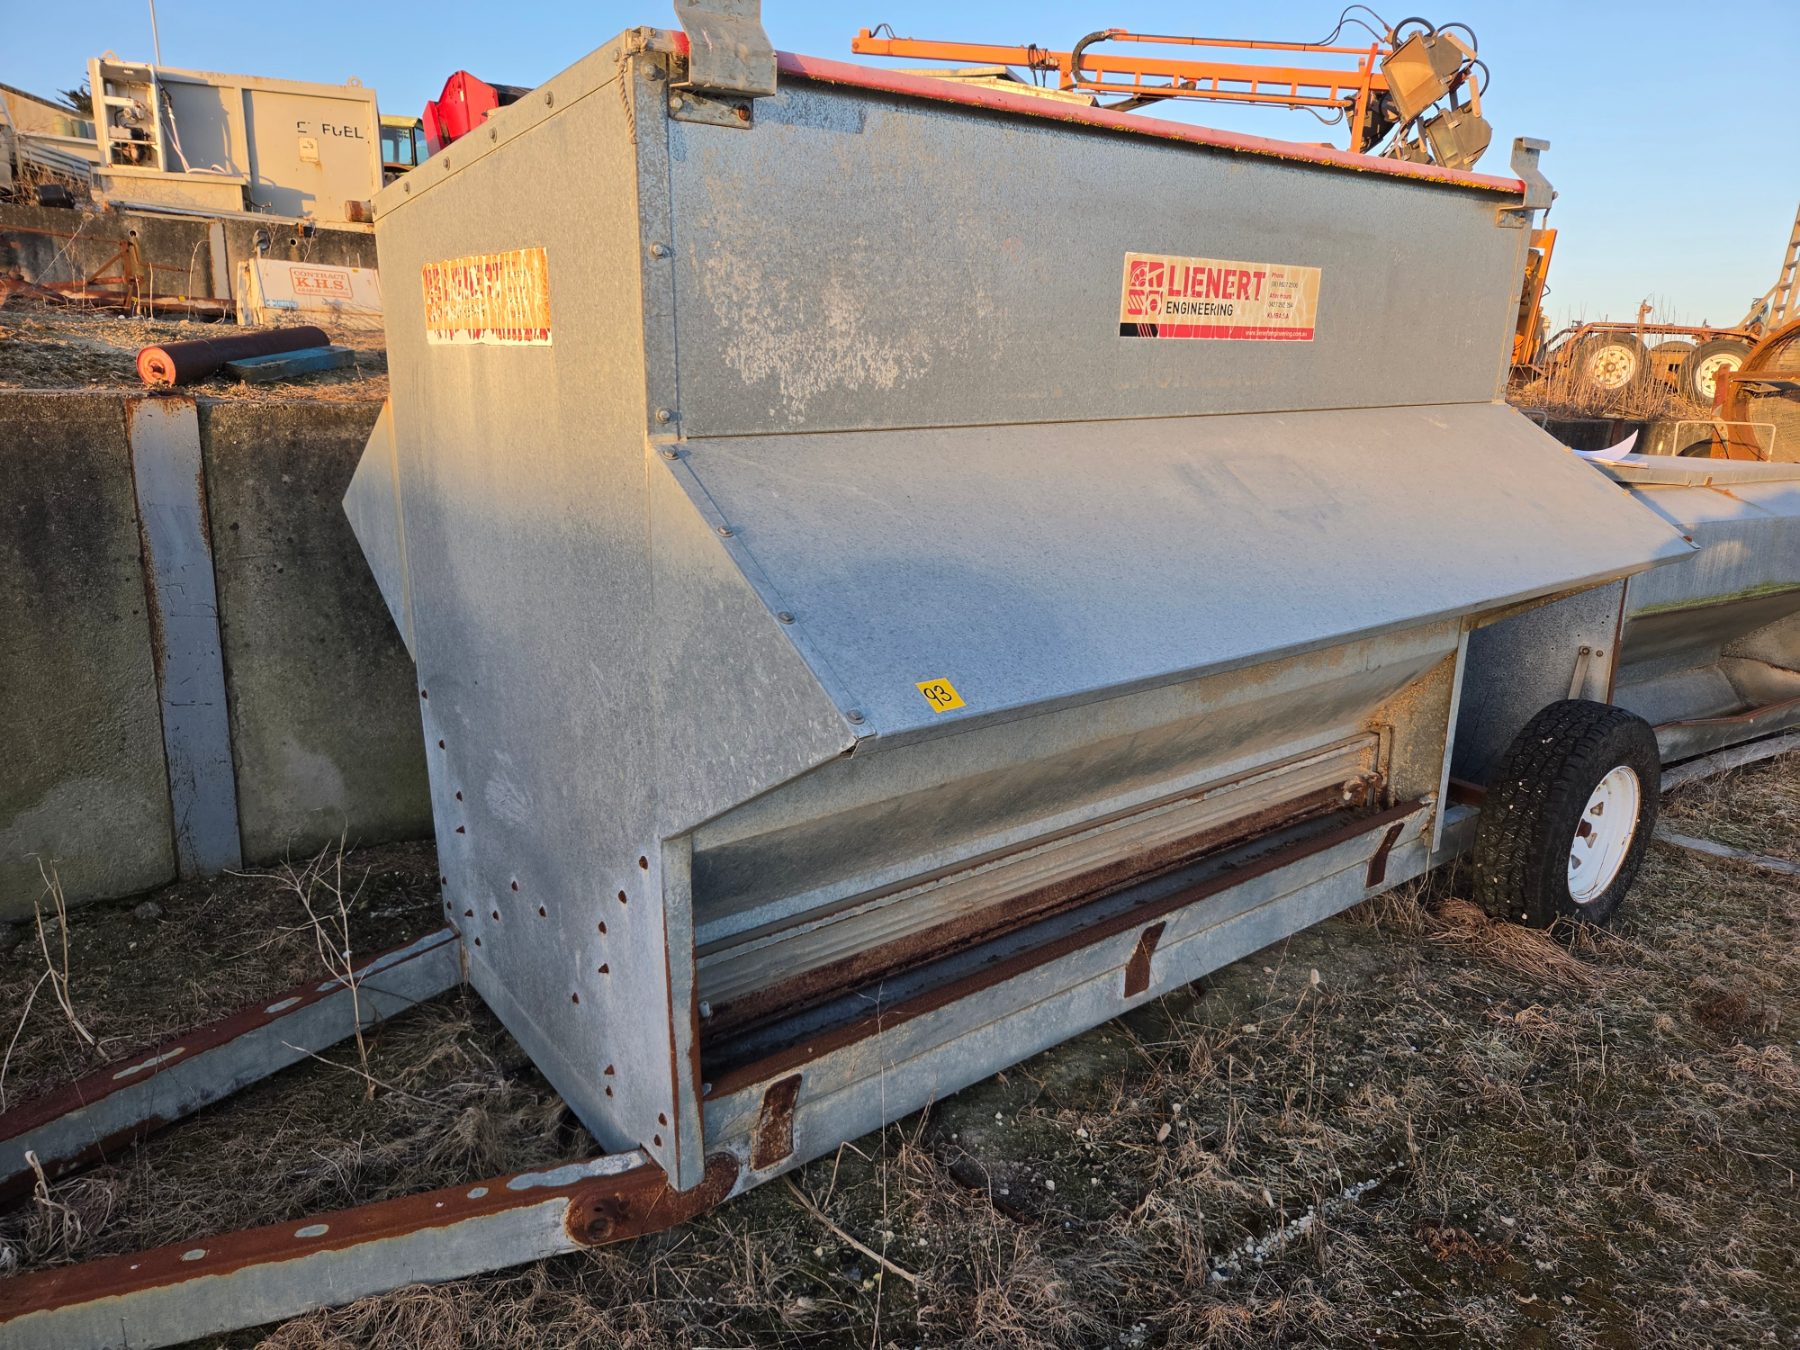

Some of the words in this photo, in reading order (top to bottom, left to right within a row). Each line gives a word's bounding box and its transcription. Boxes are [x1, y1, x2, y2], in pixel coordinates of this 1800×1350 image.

[322, 123, 364, 139] FUEL
[293, 270, 346, 280] CONTRACT
[1167, 265, 1266, 301] LIENERT
[295, 277, 349, 291] K.H.S.
[1166, 301, 1234, 317] ENGINEERING
[923, 685, 952, 706] 93
